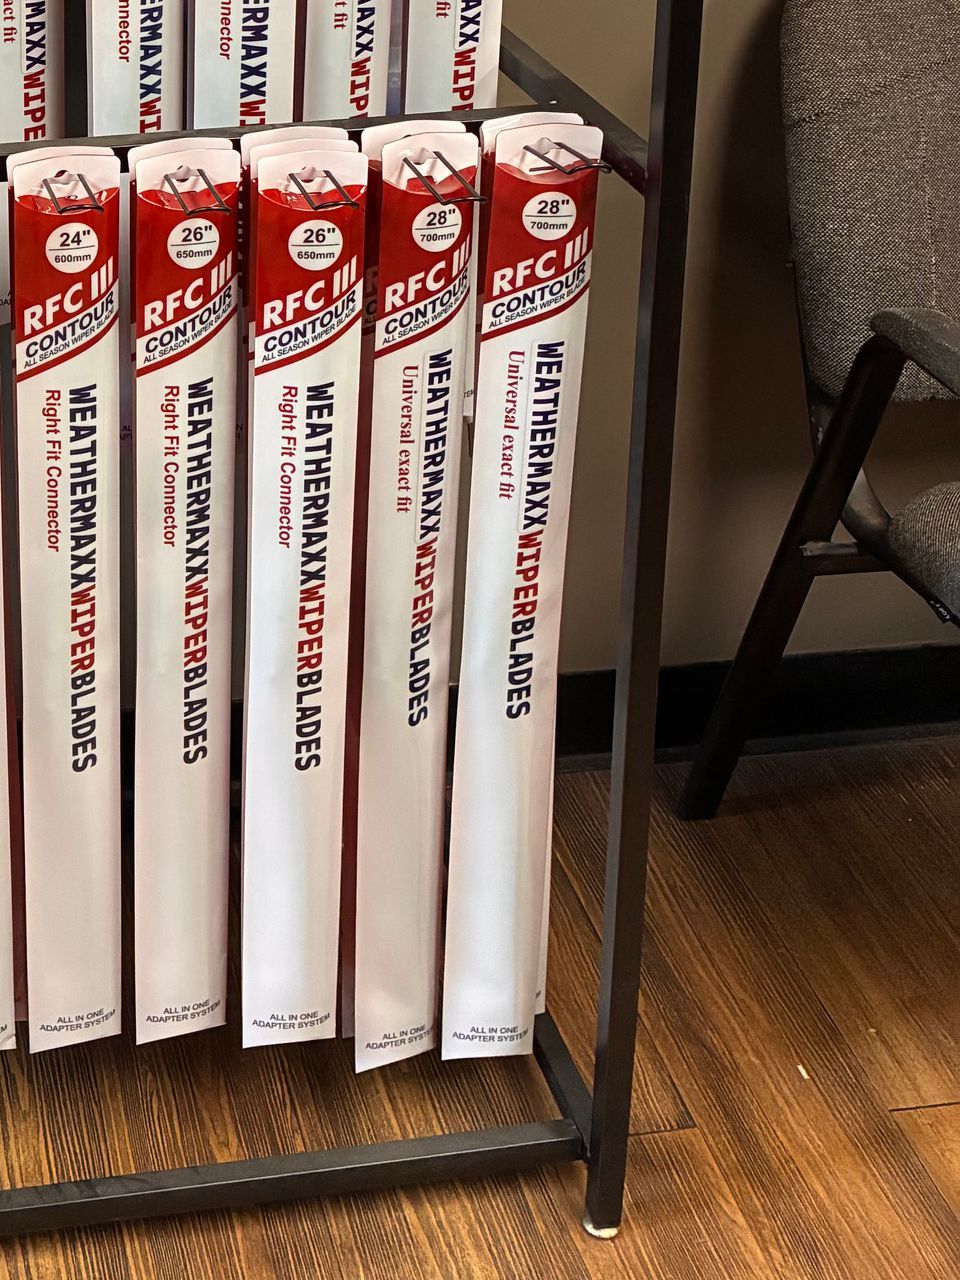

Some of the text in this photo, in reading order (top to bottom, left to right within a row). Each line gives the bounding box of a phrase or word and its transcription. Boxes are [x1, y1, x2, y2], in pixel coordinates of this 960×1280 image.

[537, 199, 569, 214] 28"
[426, 209, 456, 226] 28"
[531, 221, 567, 229] 700mm
[60, 230, 90, 247] 24"
[182, 225, 212, 242] 26"
[303, 227, 335, 243] 26"
[421, 233, 454, 242] 700mm
[55, 254, 91, 263] 600mm
[176, 250, 212, 258] 650mm
[298, 251, 334, 259] 650mm
[144, 251, 233, 331] RFC III
[492, 261, 585, 319] CONTOUR
[384, 267, 468, 334] CONTOUR
[26, 291, 113, 359] CONTOUR
[145, 285, 232, 353] CONTOUR
[264, 293, 356, 353] CONTOUR
[499, 350, 525, 500] Universal exact fit
